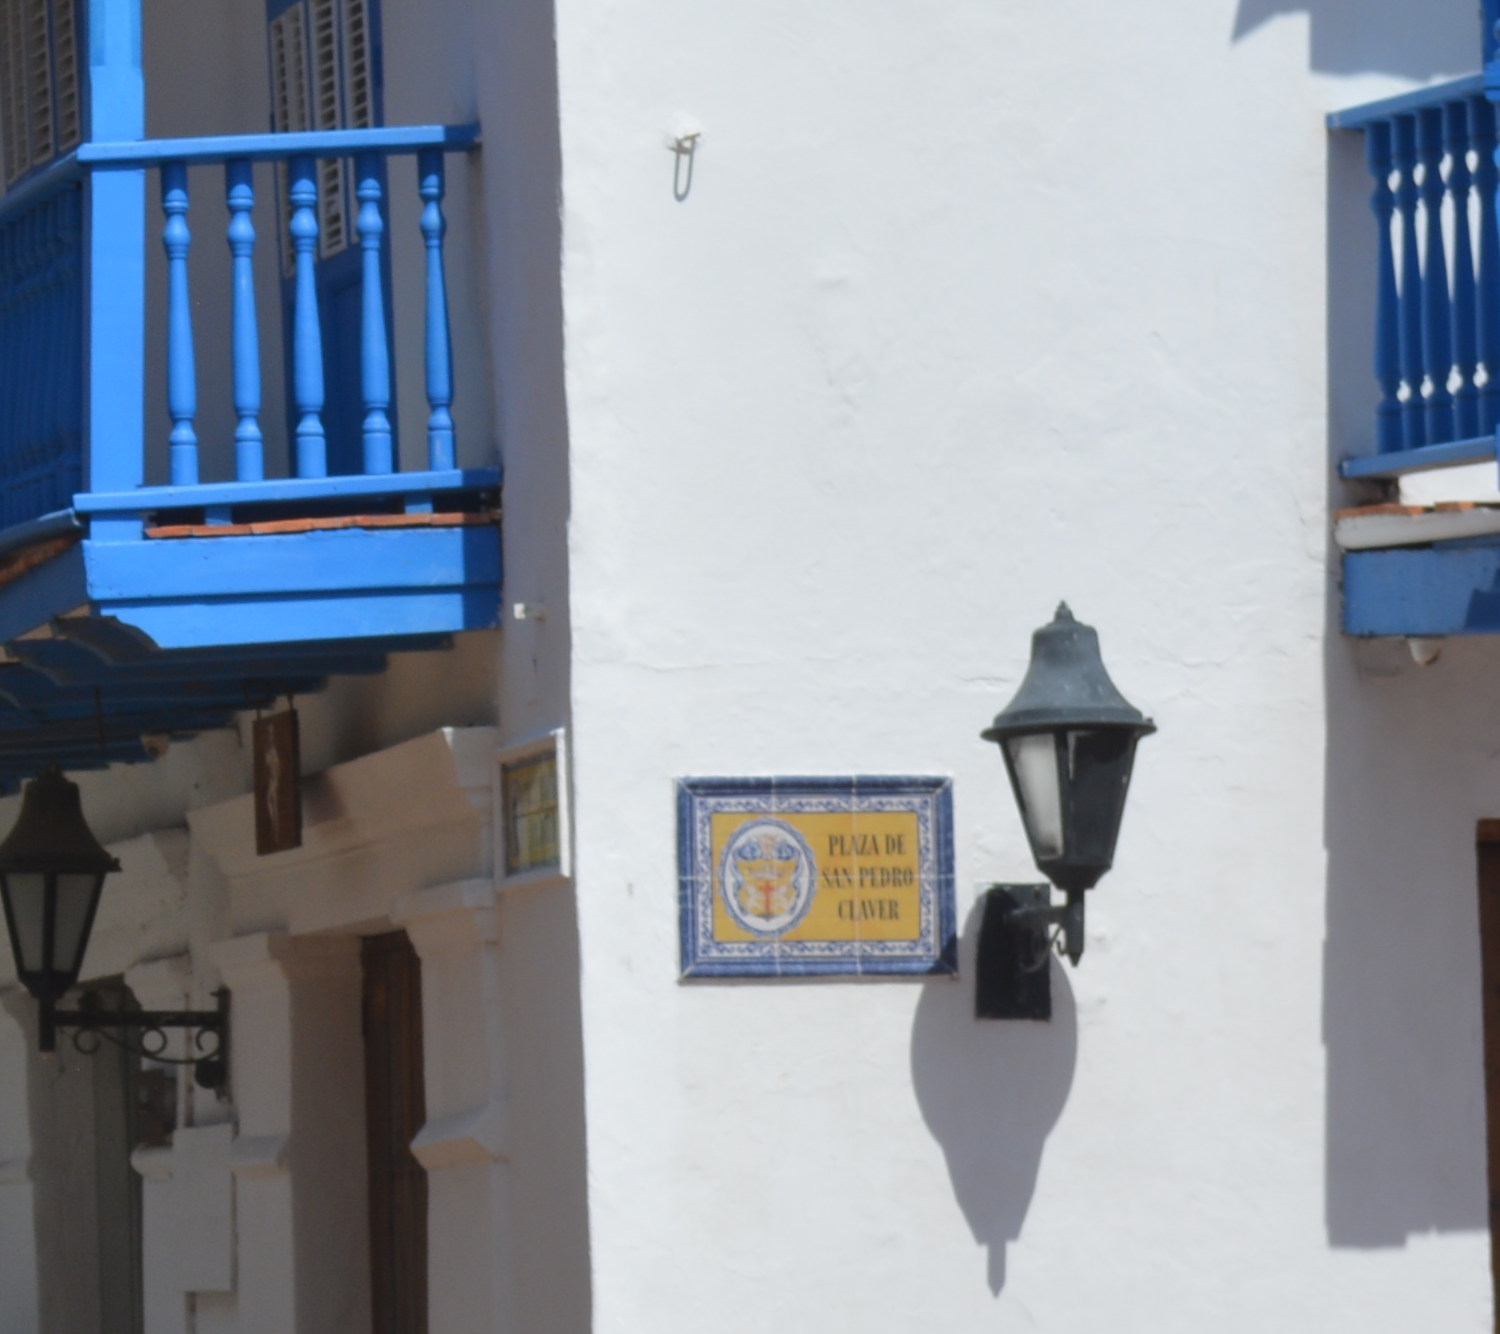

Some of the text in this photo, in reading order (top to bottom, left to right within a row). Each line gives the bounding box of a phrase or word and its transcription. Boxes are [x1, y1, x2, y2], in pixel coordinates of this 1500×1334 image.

[829, 833, 906, 857] PLAZA DE
[821, 865, 914, 889] SAN PEDRO
[837, 899, 900, 921] CLAVER
